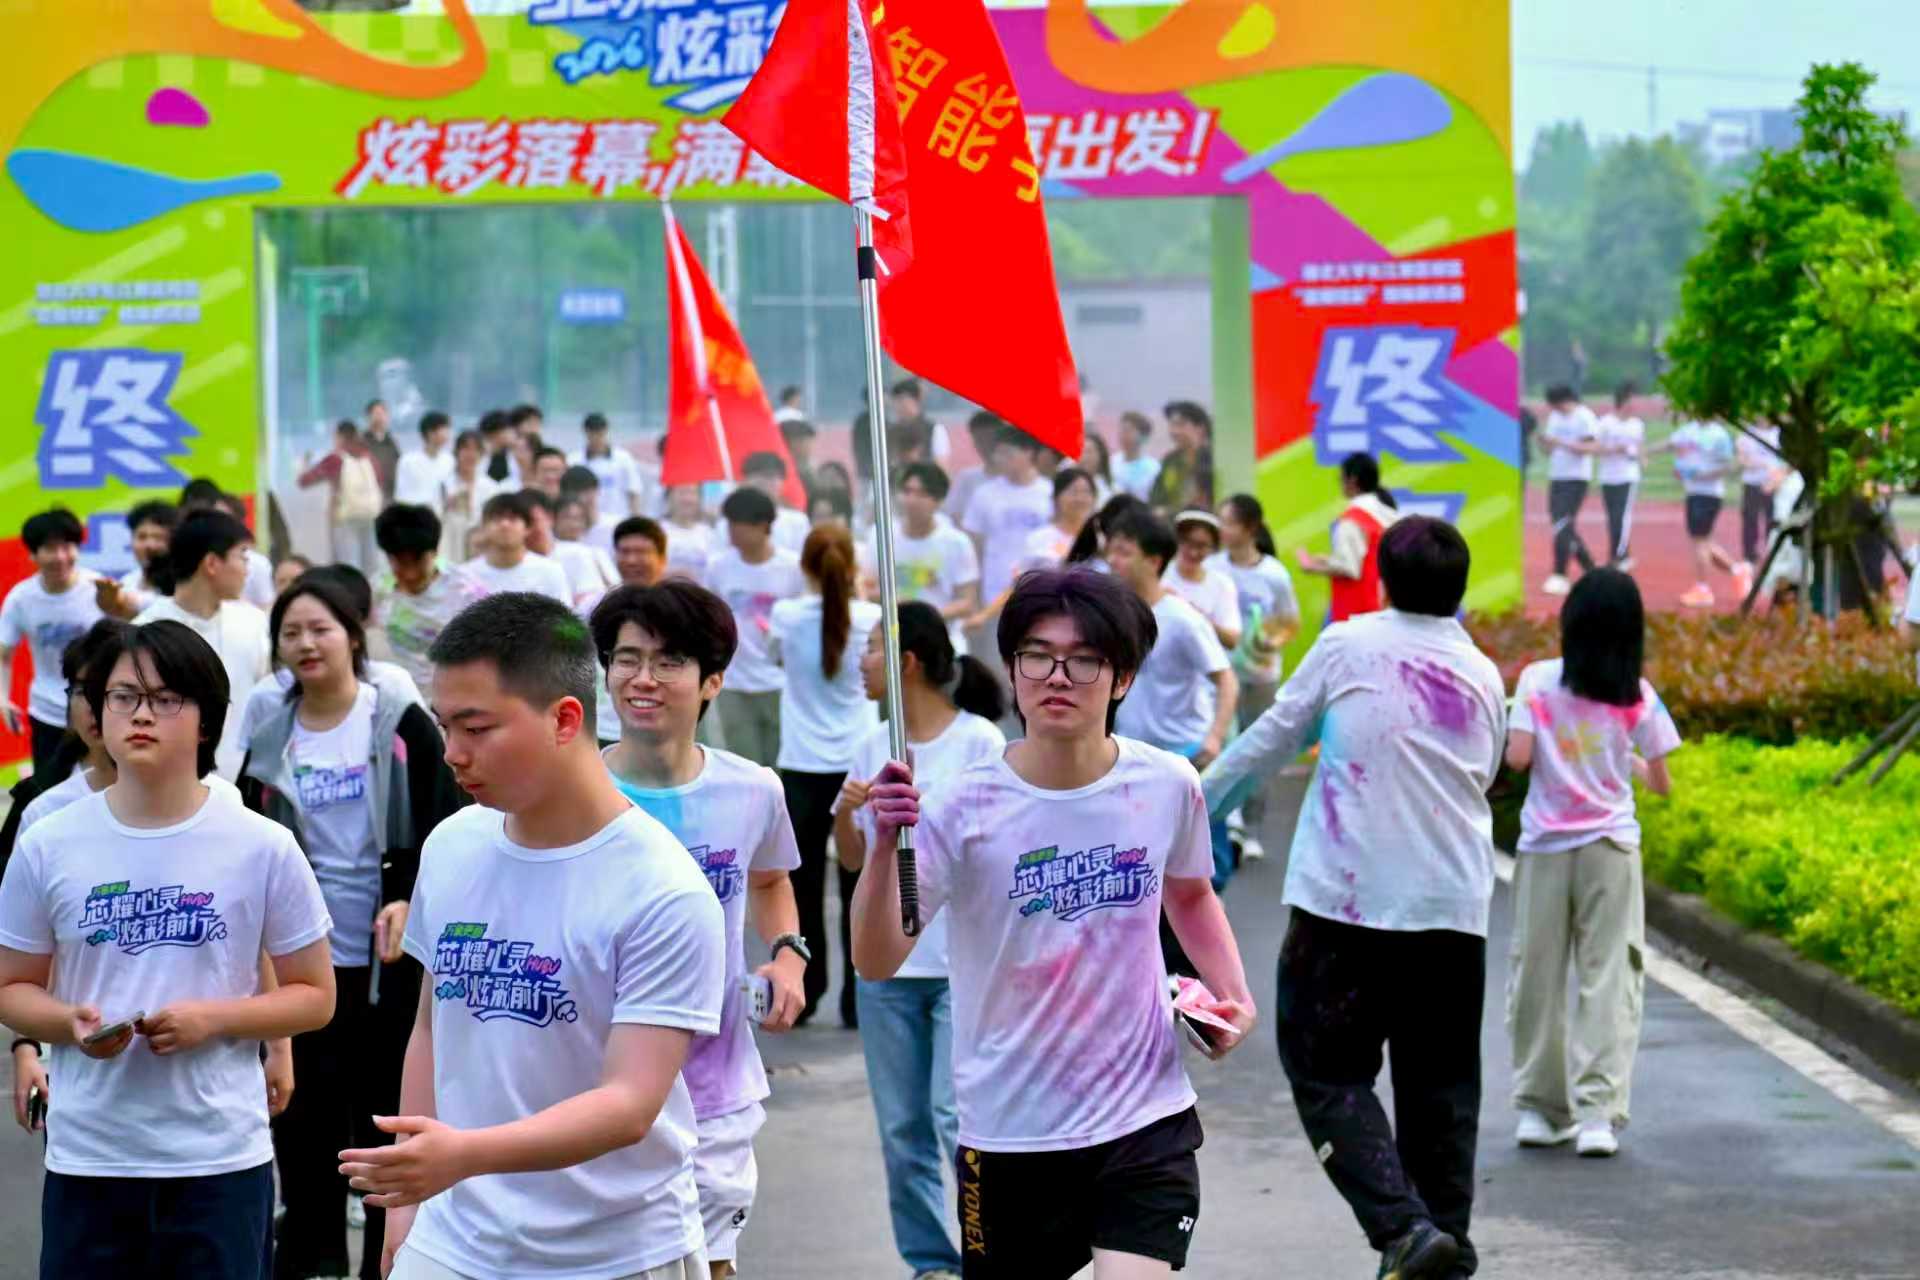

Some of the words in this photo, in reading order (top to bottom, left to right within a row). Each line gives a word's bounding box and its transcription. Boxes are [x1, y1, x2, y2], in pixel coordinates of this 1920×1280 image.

[1010, 844, 1116, 898] 芯耀心灵
[1053, 864, 1153, 914] 炫彩前行
[79, 885, 184, 928] 芯耀心灵
[118, 909, 220, 949] 炫彩前行
[433, 939, 534, 976] 芯耀心灵
[467, 975, 569, 1020] 炫彩前行
[963, 1180, 987, 1256] YONEX
